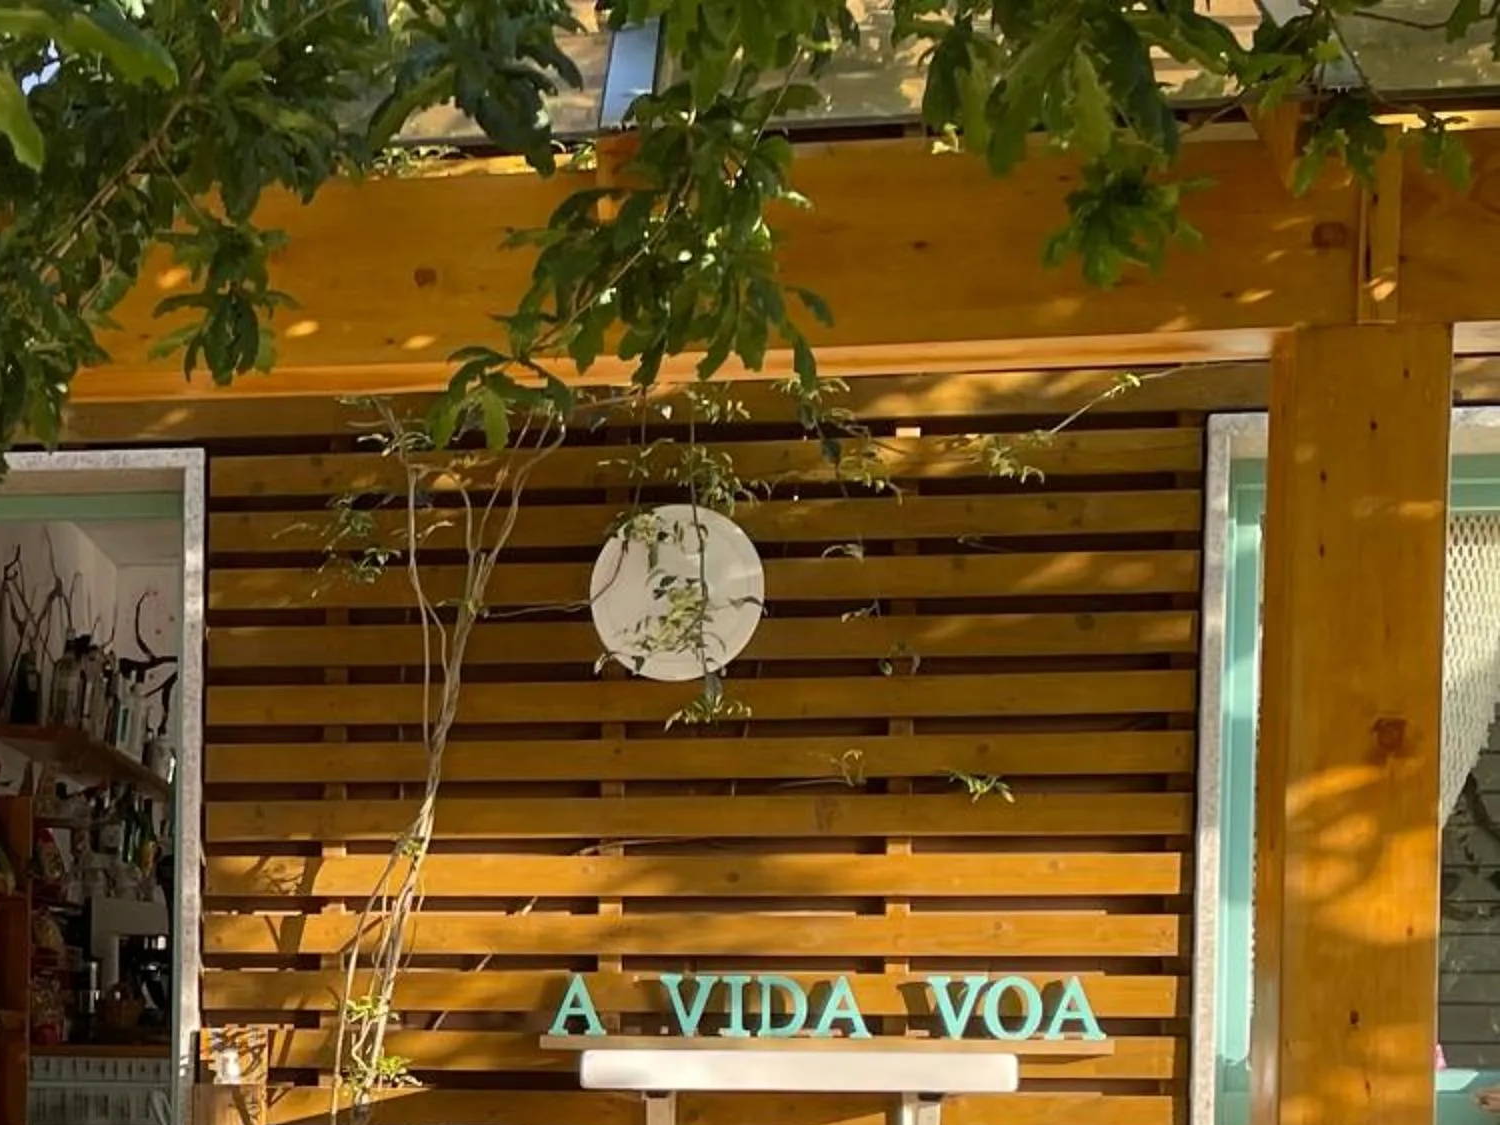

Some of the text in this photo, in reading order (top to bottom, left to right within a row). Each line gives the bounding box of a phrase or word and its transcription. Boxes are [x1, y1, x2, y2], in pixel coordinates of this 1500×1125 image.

[548, 972, 1107, 1041] A VIDA VOA
